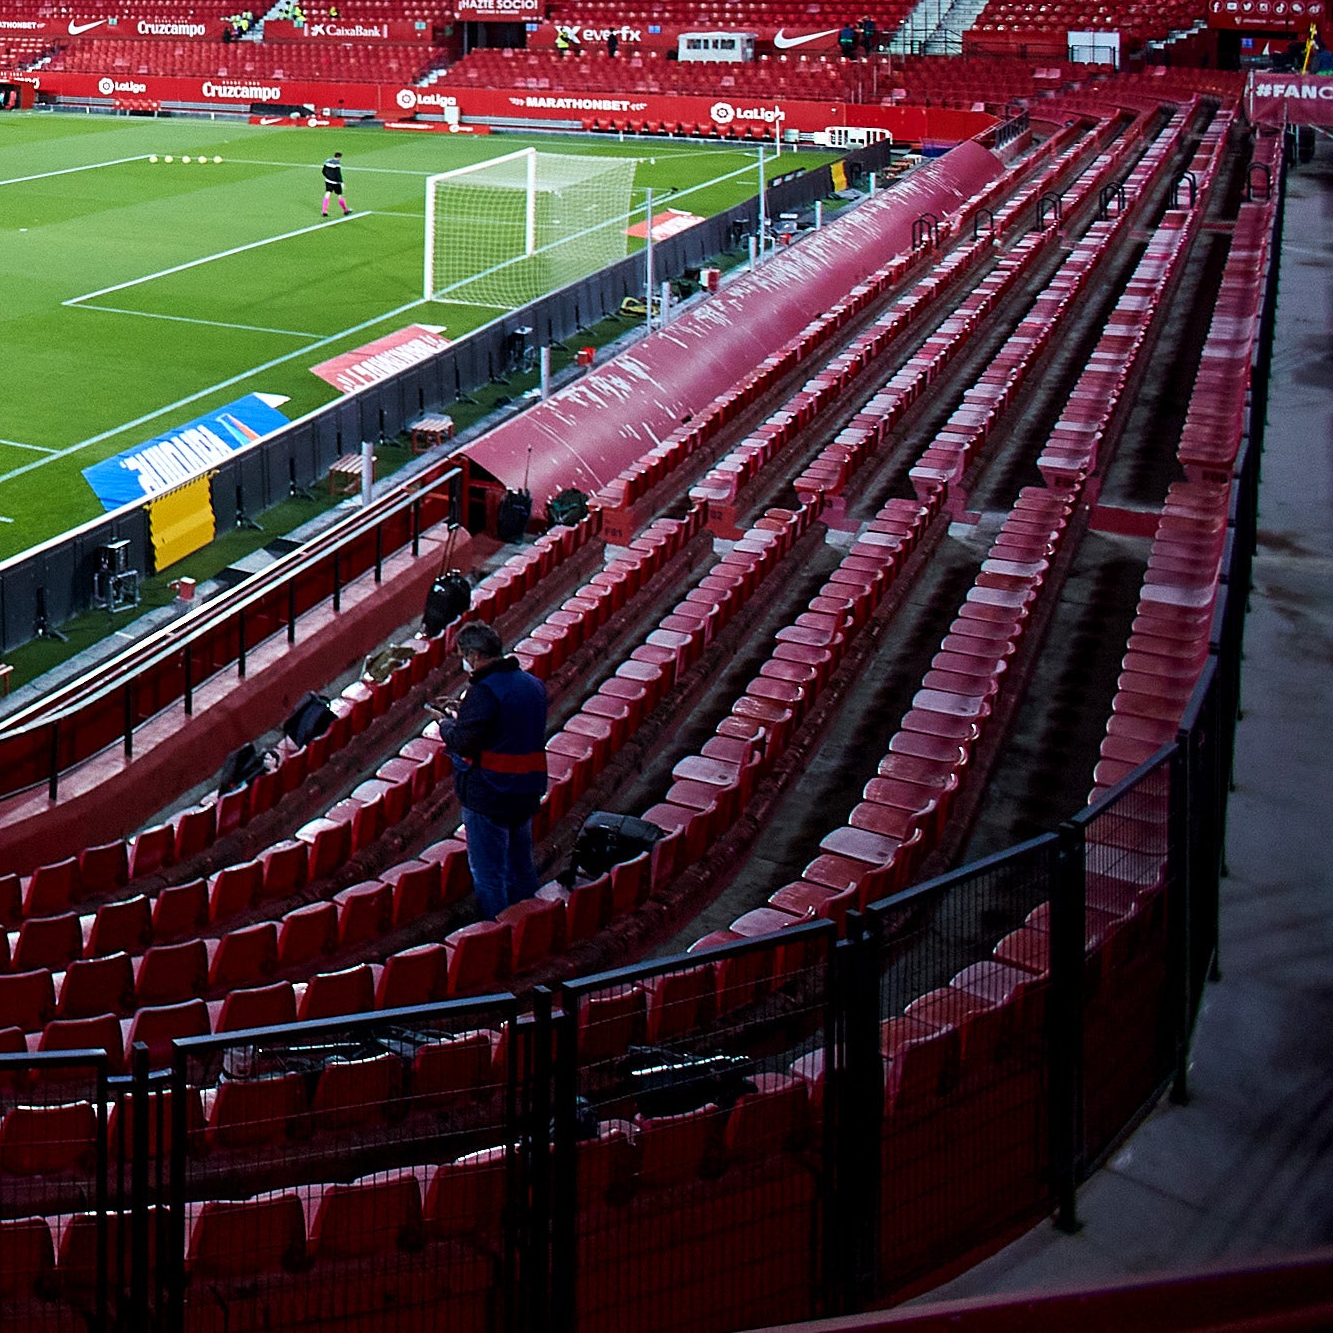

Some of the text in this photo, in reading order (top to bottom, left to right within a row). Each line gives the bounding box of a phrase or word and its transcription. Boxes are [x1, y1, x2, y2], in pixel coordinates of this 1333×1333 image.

[458, 0, 538, 11] ¡HAZTE SOCIO!
[137, 20, 206, 37] Cruzcampo
[325, 24, 381, 37] CaixaBank
[114, 81, 146, 93] LaLiga
[202, 81, 281, 101] Cruzcampo
[417, 94, 457, 106] LaLiga
[526, 97, 631, 112] MARATHONBET
